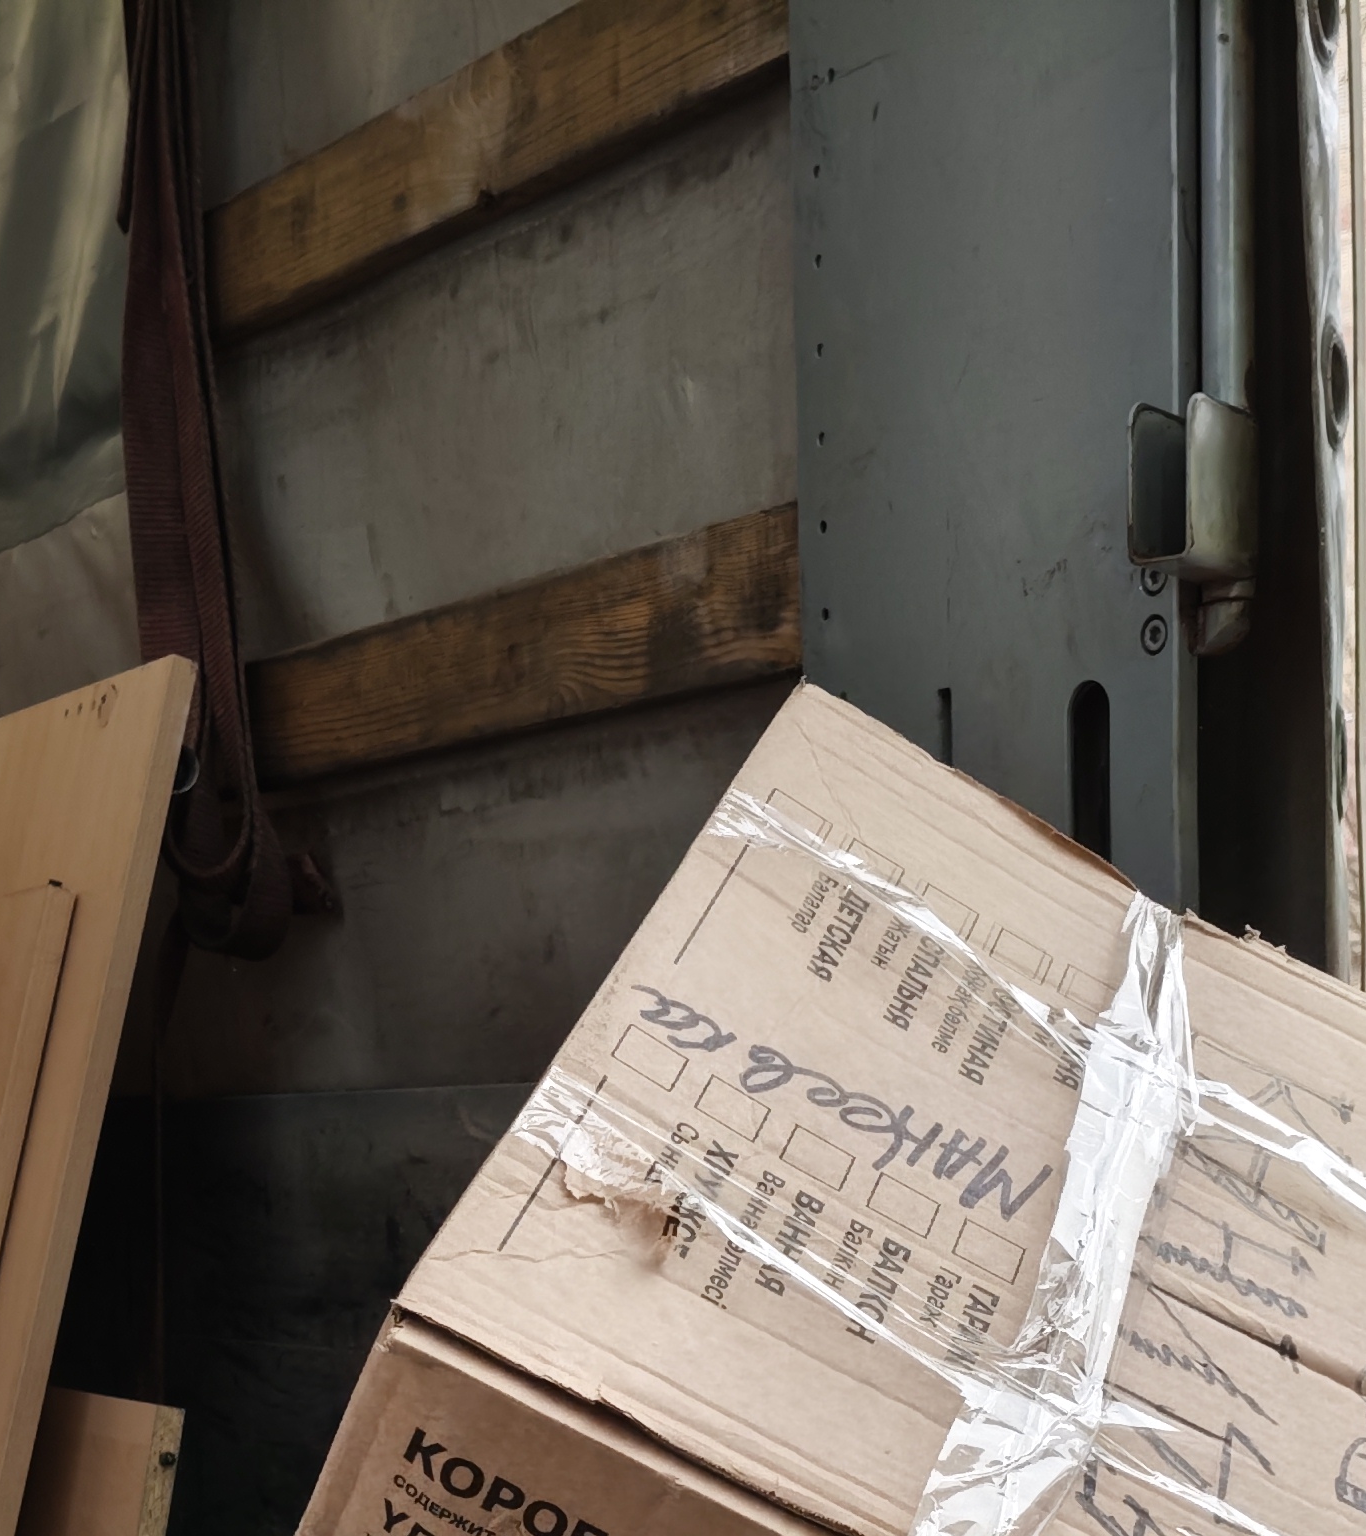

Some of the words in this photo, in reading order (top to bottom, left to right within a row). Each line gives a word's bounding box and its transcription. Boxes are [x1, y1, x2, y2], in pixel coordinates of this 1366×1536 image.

[791, 871, 840, 934] Балалар
[806, 888, 871, 983] ДЕТСКАЯ
[870, 916, 912, 971] Жатын
[882, 935, 946, 1032] СПАЛЬНЯ
[926, 1002, 972, 1058] бөлме
[952, 982, 1027, 1086] ОСТИНАЯ
[736, 1169, 786, 1233] Ванна
[698, 1224, 757, 1311] өлмесі
[819, 1218, 874, 1293] Балкон
[845, 1236, 913, 1345] БАЛКОН
[909, 1263, 963, 1328] Гараж
